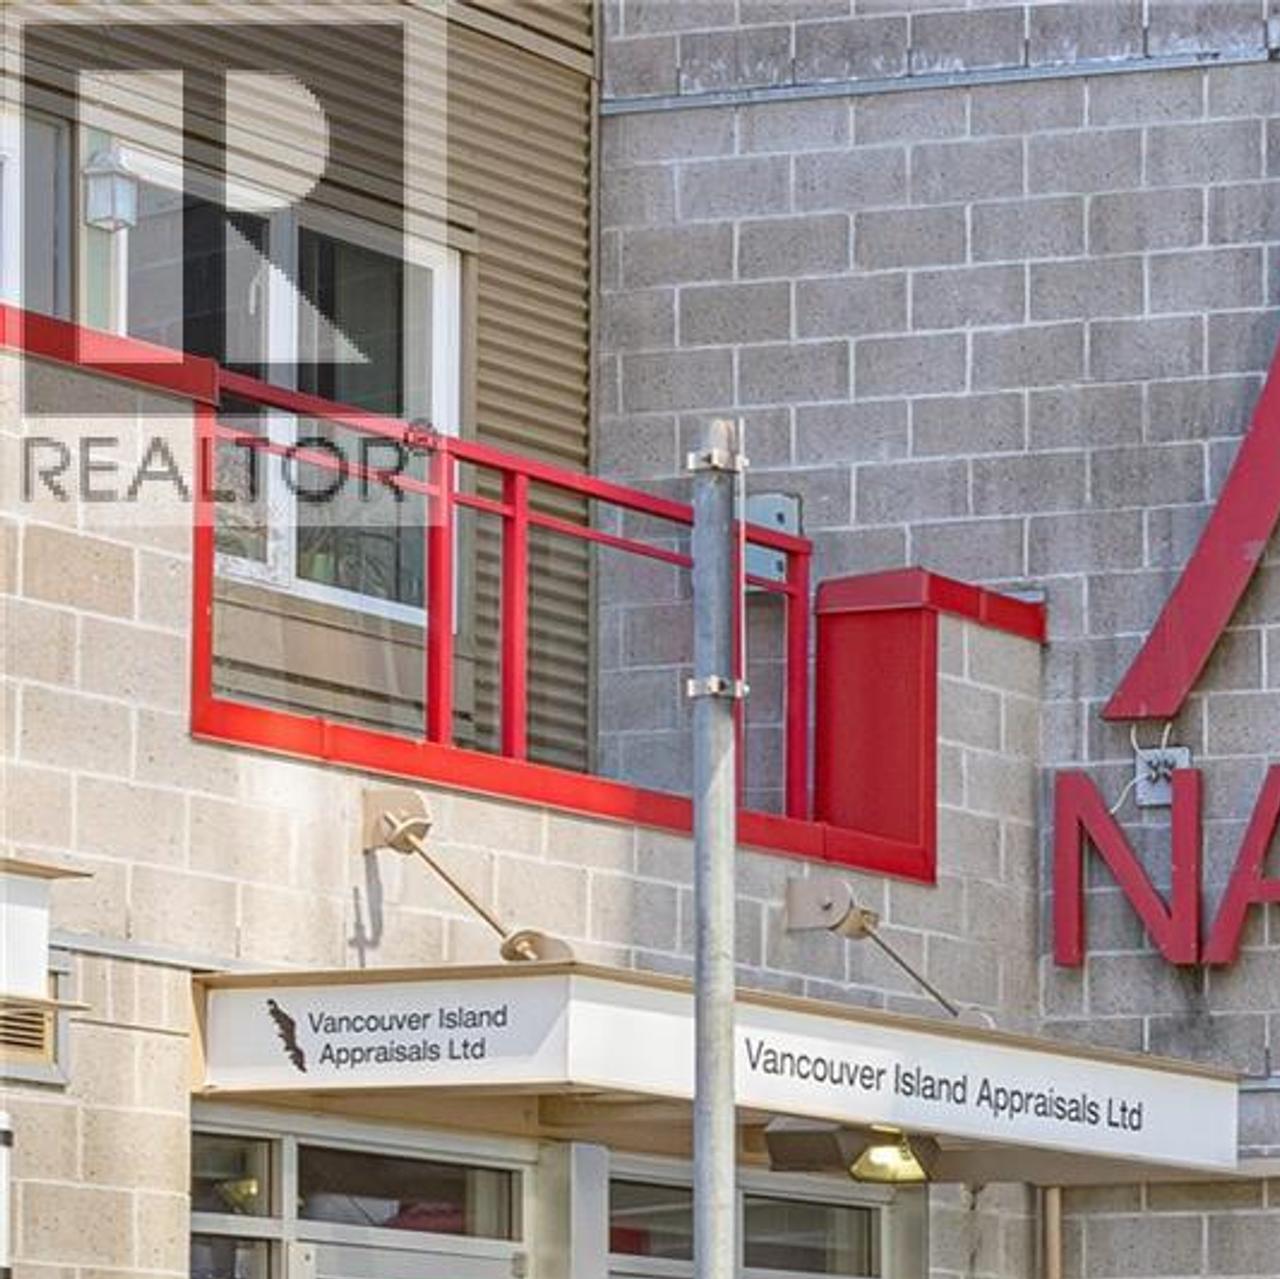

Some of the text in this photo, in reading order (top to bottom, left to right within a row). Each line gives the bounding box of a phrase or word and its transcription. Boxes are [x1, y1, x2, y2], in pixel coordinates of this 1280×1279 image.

[307, 1005, 508, 1035] Vancouver Island
[319, 1038, 486, 1069] Appraisals Ltd
[745, 1037, 1143, 1132] Vancouver Island Appraisals Ltd
